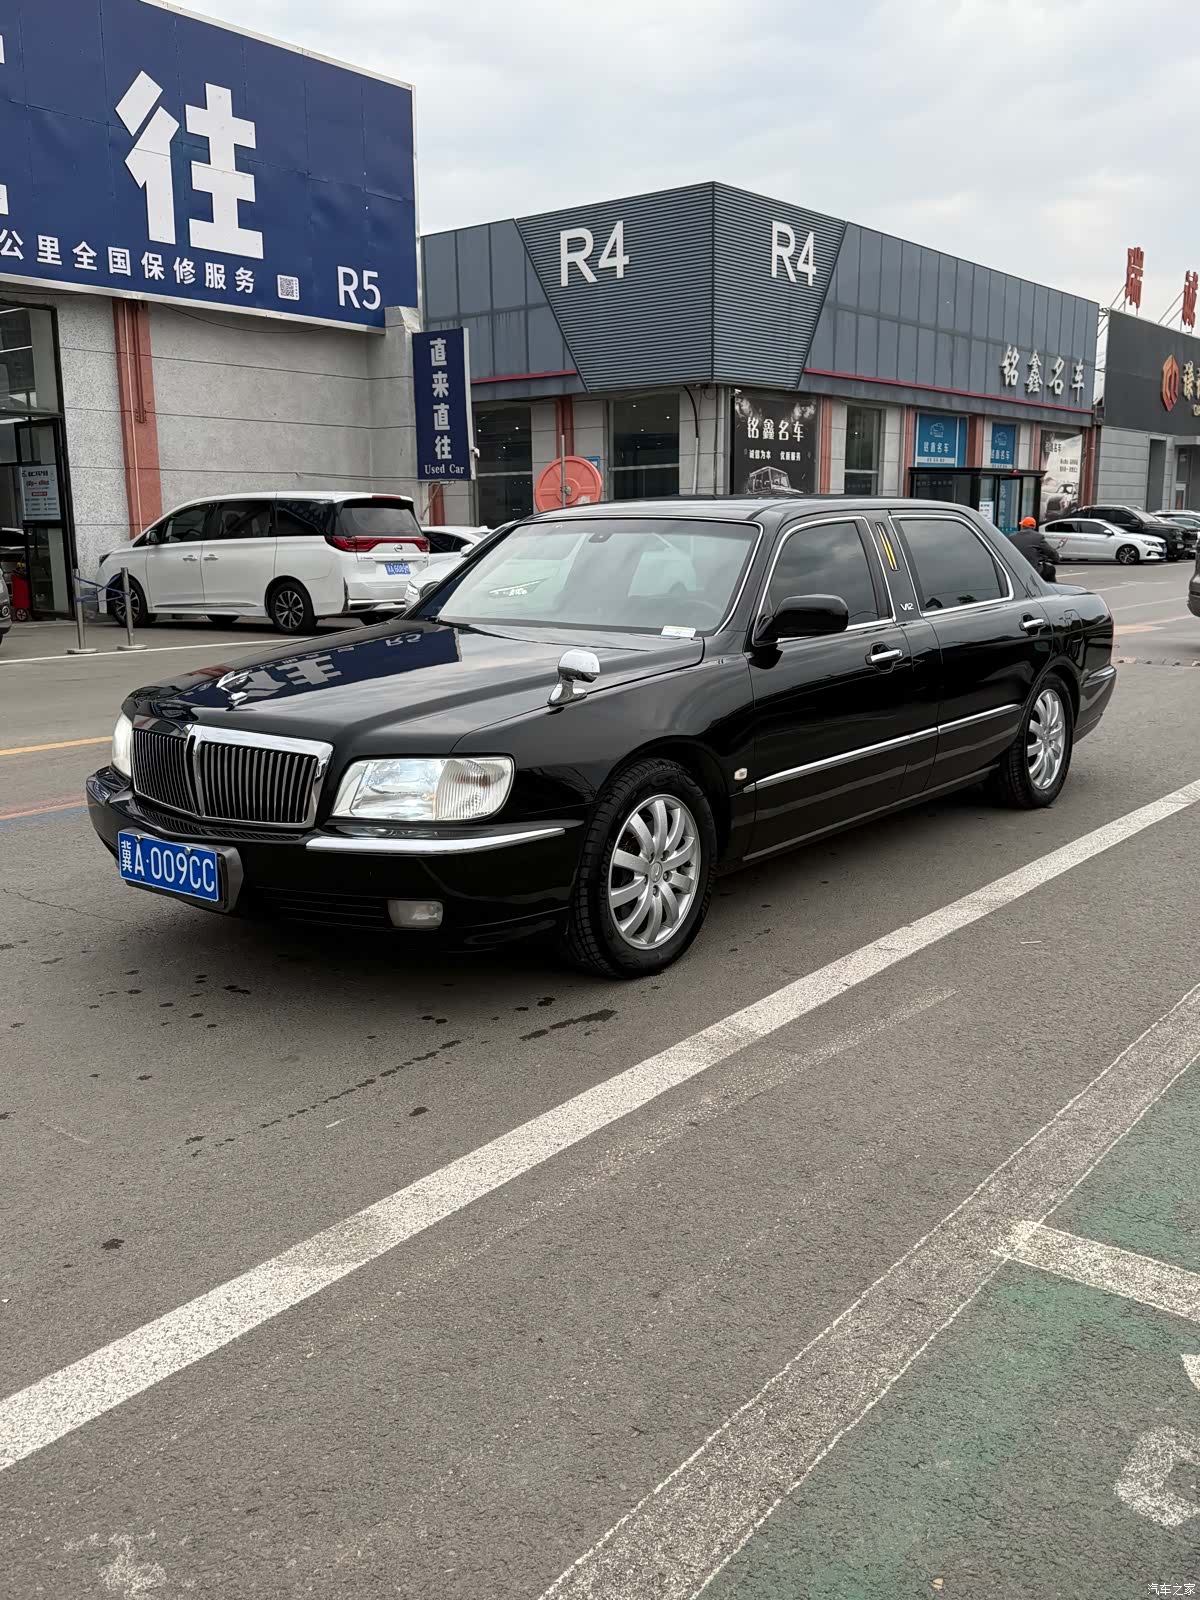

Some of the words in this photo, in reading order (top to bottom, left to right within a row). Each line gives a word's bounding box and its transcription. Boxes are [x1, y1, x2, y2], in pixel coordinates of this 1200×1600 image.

[0, 229, 255, 294] 公里全国保修服务
[560, 220, 629, 287] R4
[771, 220, 816, 286] R4
[337, 265, 381, 310] R5
[430, 338, 452, 460] 直来直往
[1001, 343, 1085, 402] 铭鑫名车
[747, 416, 804, 442] 铭鑫名车
[424, 464, 445, 474] Used
[449, 464, 464, 474] Car
[121, 840, 215, 892] 冀A·009CC
